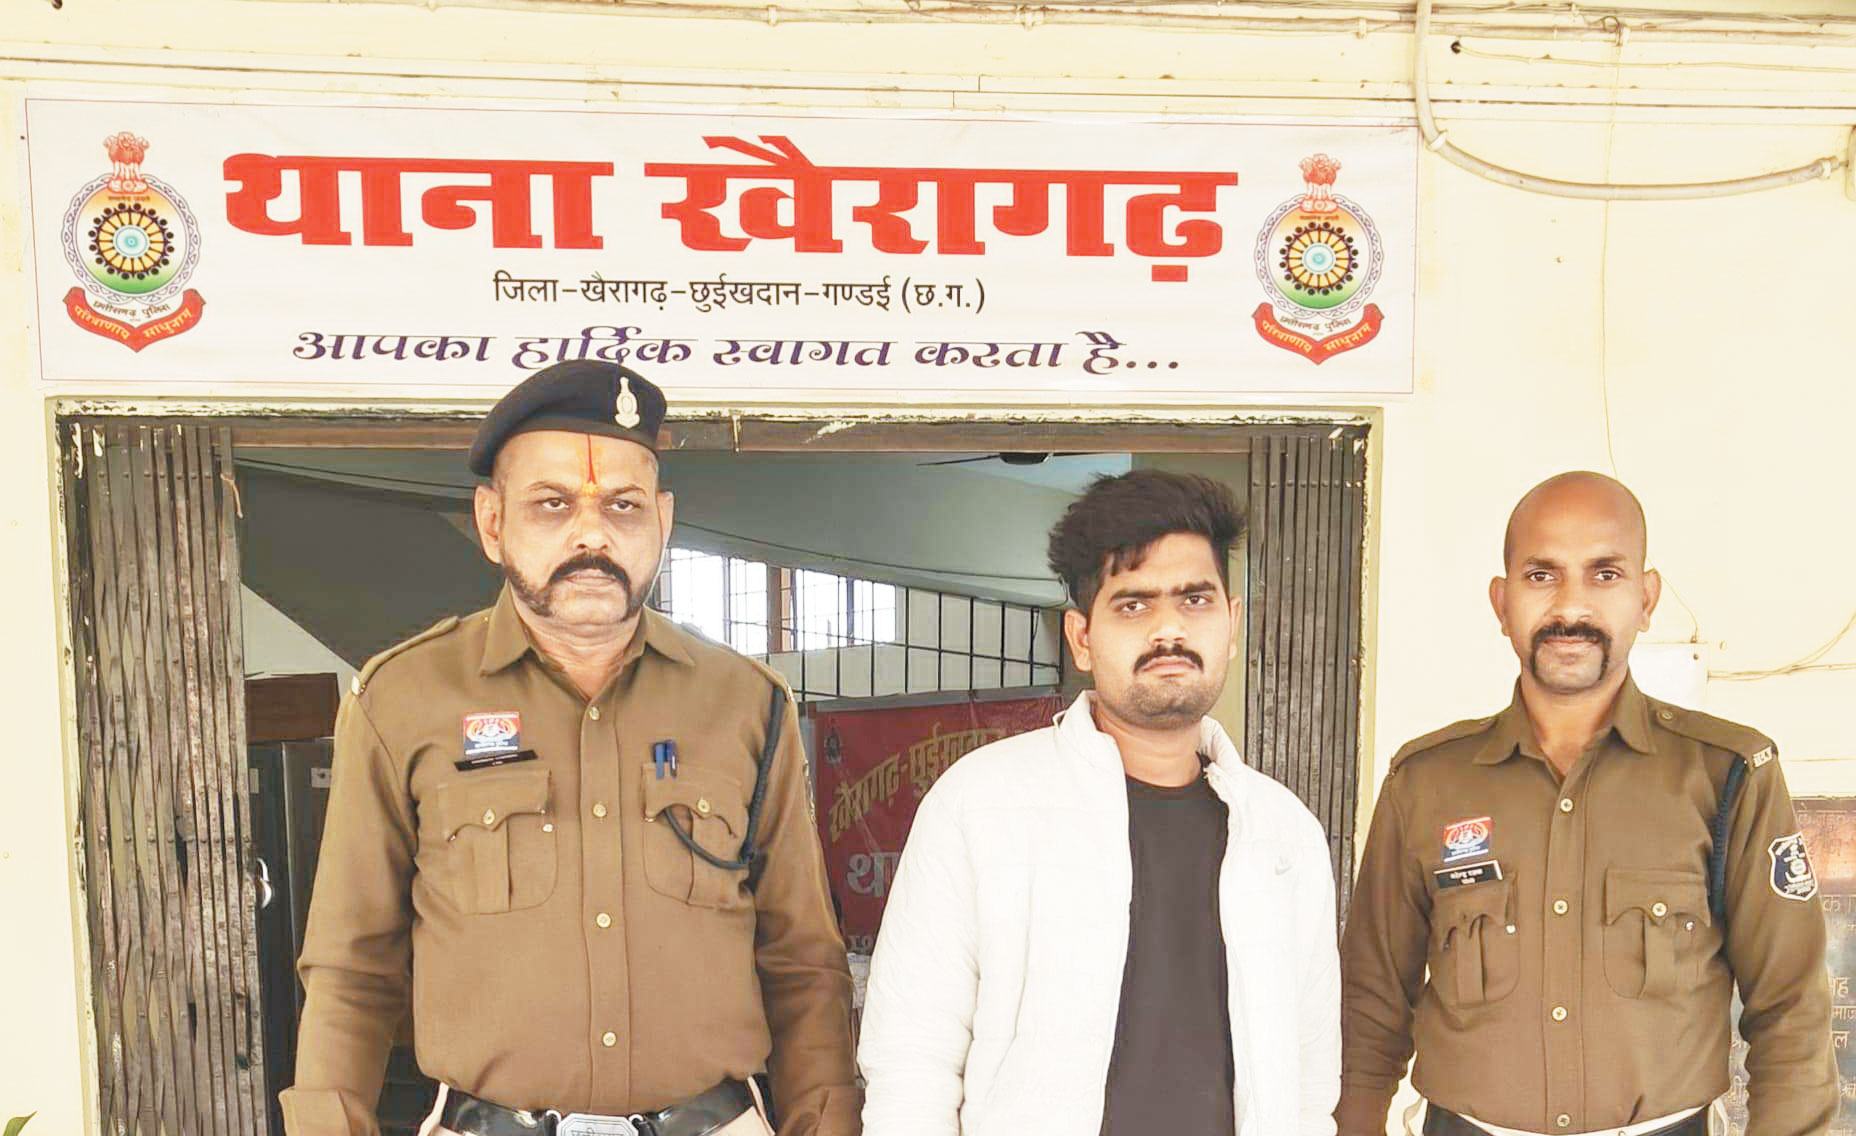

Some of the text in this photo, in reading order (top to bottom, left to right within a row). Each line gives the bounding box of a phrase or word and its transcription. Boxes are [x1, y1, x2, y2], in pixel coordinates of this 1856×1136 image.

[223, 135, 1238, 283] थाना खैरागढ़
[901, 277, 985, 314] (छ.ग.)
[292, 330, 498, 362] आपका
[511, 325, 699, 370] हार्दिक
[712, 338, 899, 366] स्वागत
[914, 341, 1070, 368] करता
